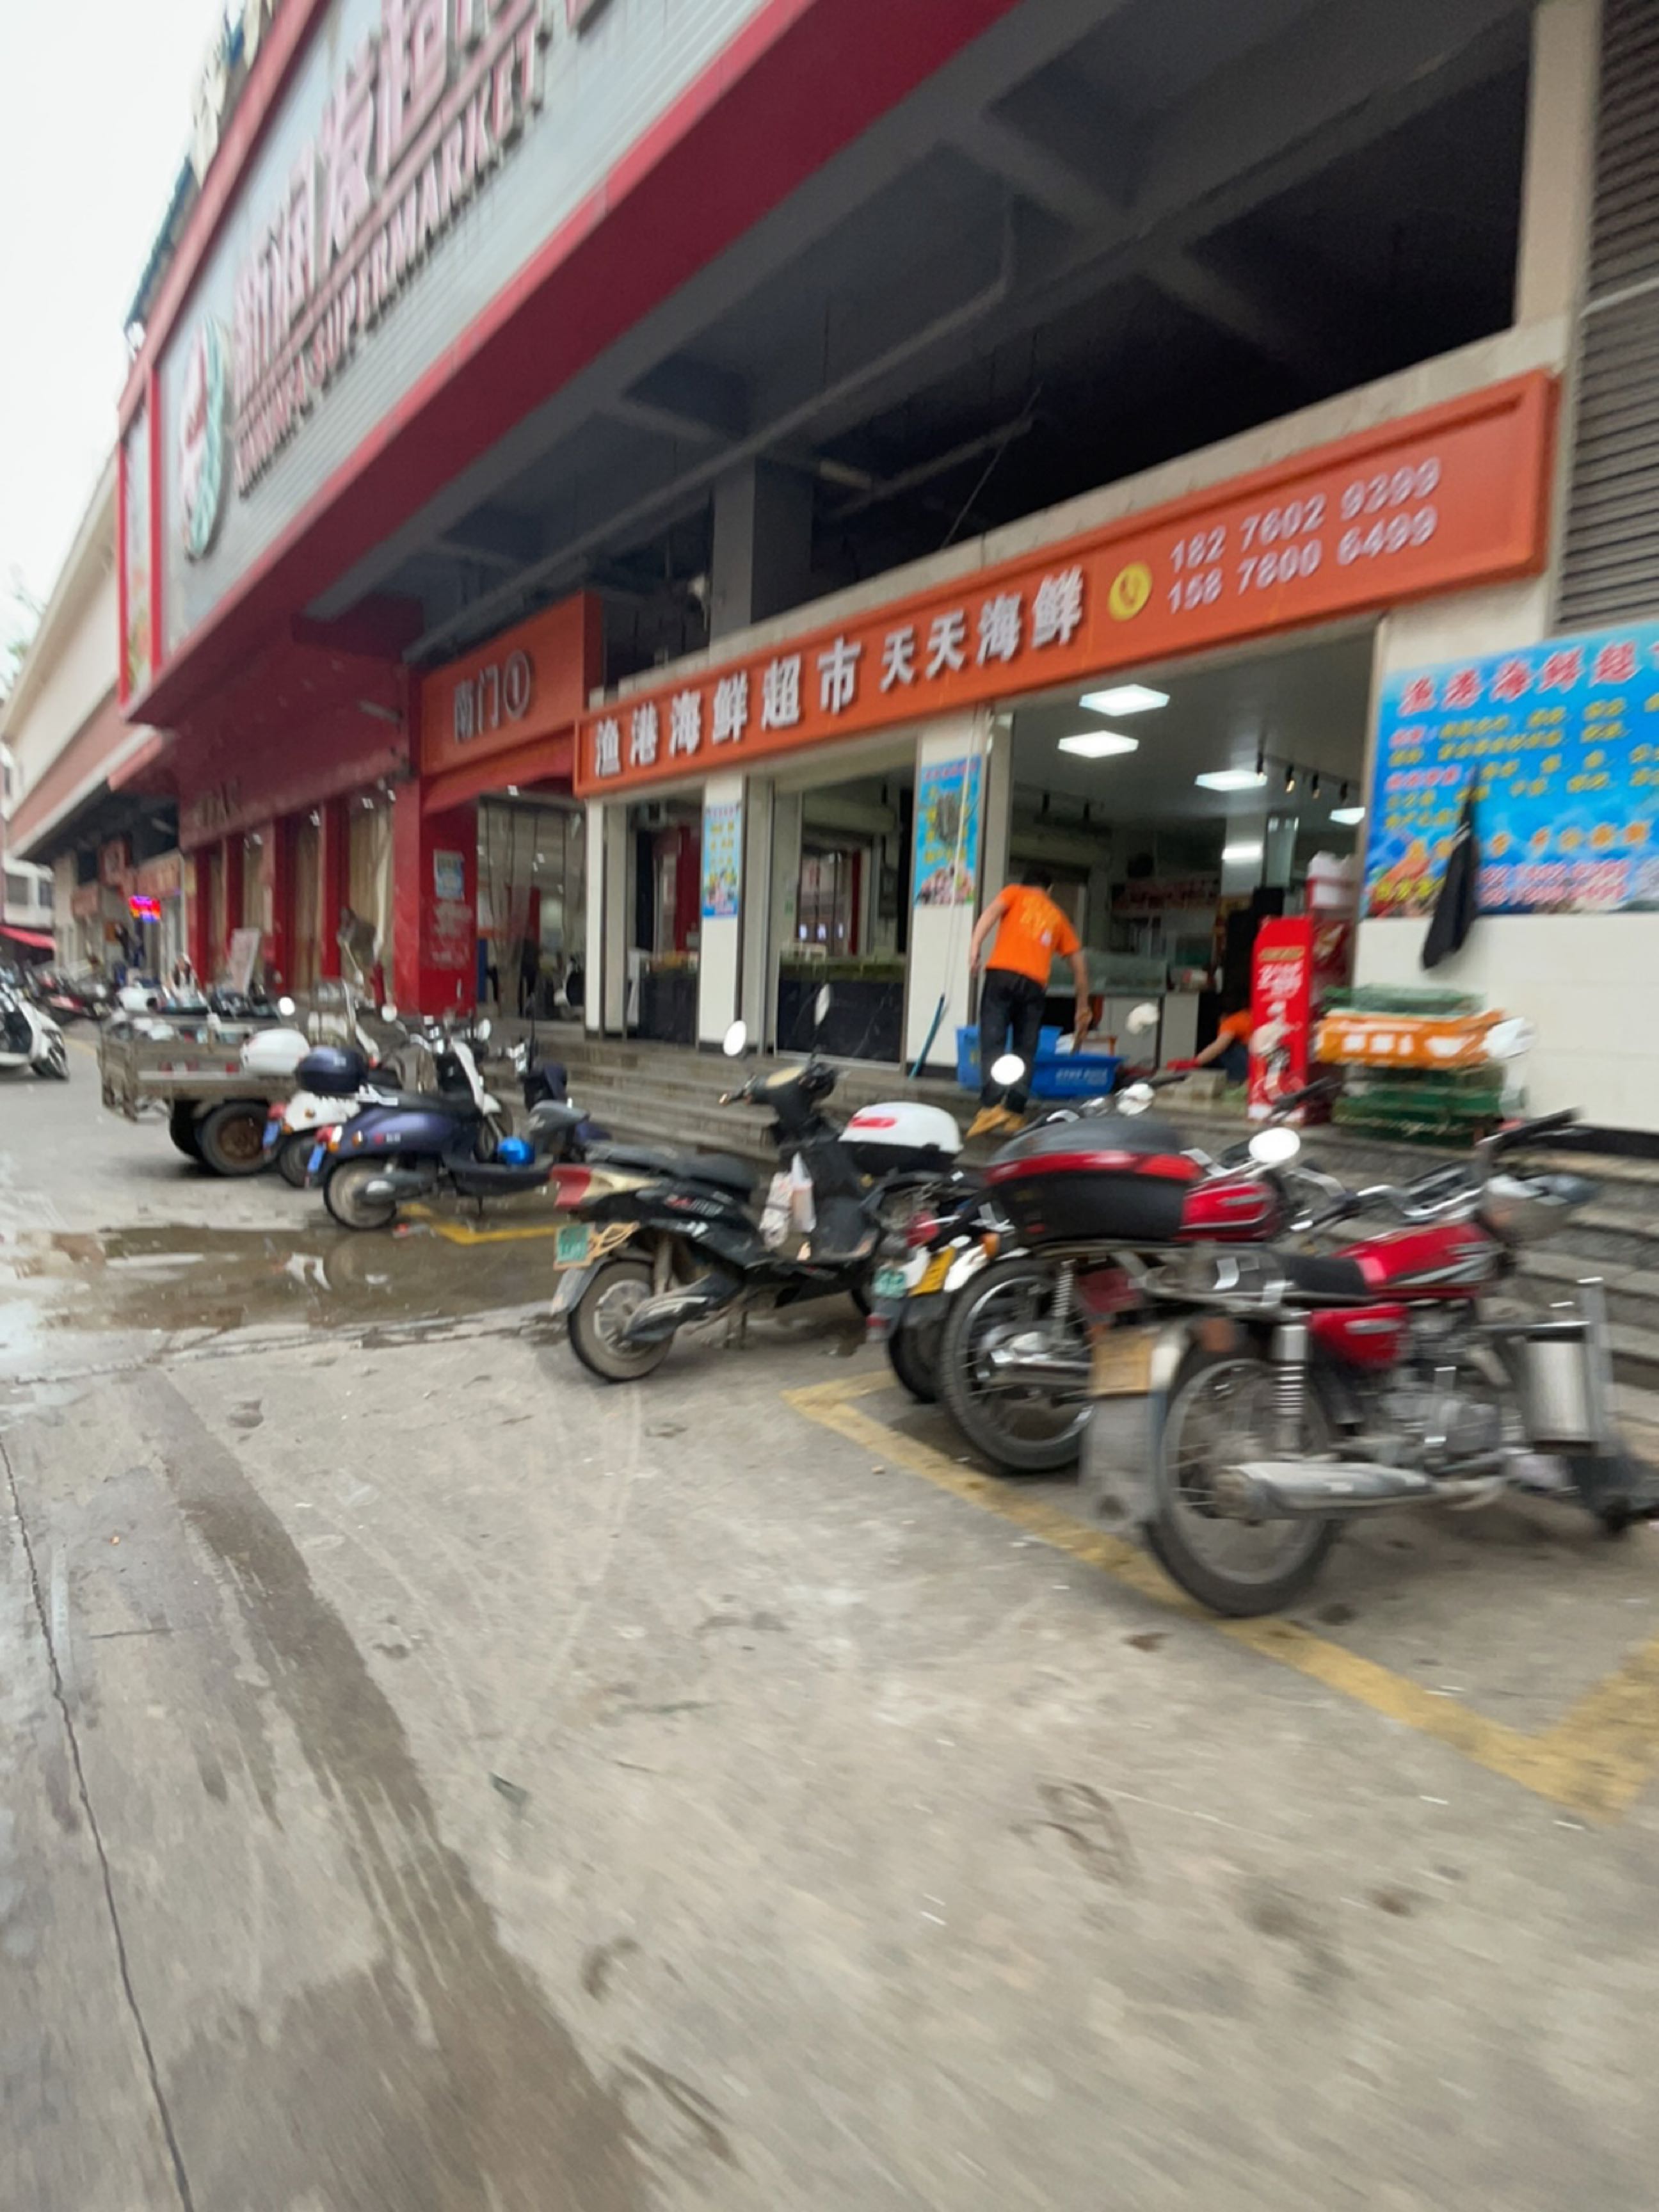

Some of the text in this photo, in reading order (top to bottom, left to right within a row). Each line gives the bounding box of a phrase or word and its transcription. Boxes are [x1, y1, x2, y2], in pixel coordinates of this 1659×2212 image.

[1171, 525, 1226, 573] 182
[1167, 568, 1222, 615] 158
[594, 565, 1082, 776] 渔港海鲜超市 天天海鲜
